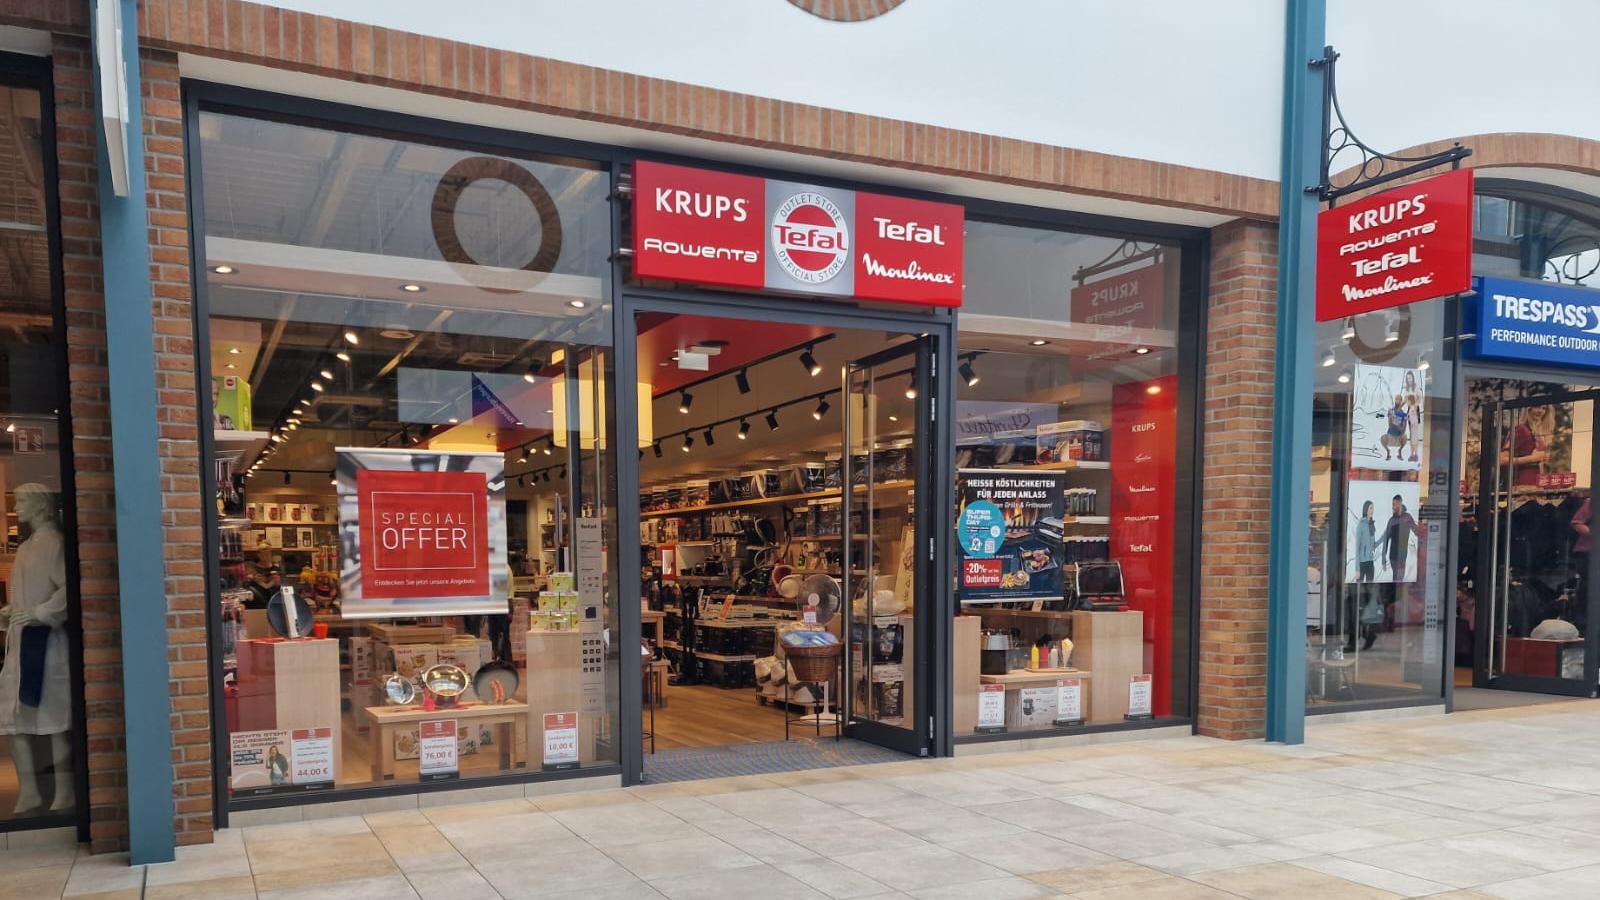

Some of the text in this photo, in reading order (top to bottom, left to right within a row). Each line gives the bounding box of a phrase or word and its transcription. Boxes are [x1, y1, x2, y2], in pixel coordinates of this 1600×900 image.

[655, 187, 747, 221] KRUPS
[780, 194, 841, 223] OUTLET STORE
[1348, 194, 1426, 233] KRUPS
[773, 224, 848, 251] Tefal
[873, 217, 945, 245] Tefal
[779, 250, 843, 281] OFFICIAL STORE
[862, 252, 955, 284] Moulinex
[1351, 246, 1422, 277] Tefal
[1341, 275, 1433, 302] Moulinex
[1493, 294, 1588, 328] TRESPASS
[1491, 328, 1557, 347] PERFORMANCE
[1558, 332, 1598, 351] OUTDOOR
[1131, 423, 1156, 433] KRUPS
[967, 477, 1056, 488] HEISSE KÖSTLICHKEITEN
[976, 488, 1047, 499] FÜR JEDEN ANLASS
[381, 512, 467, 525] SPECIAL
[382, 527, 468, 550] OFFER
[1130, 544, 1153, 553] Tefal
